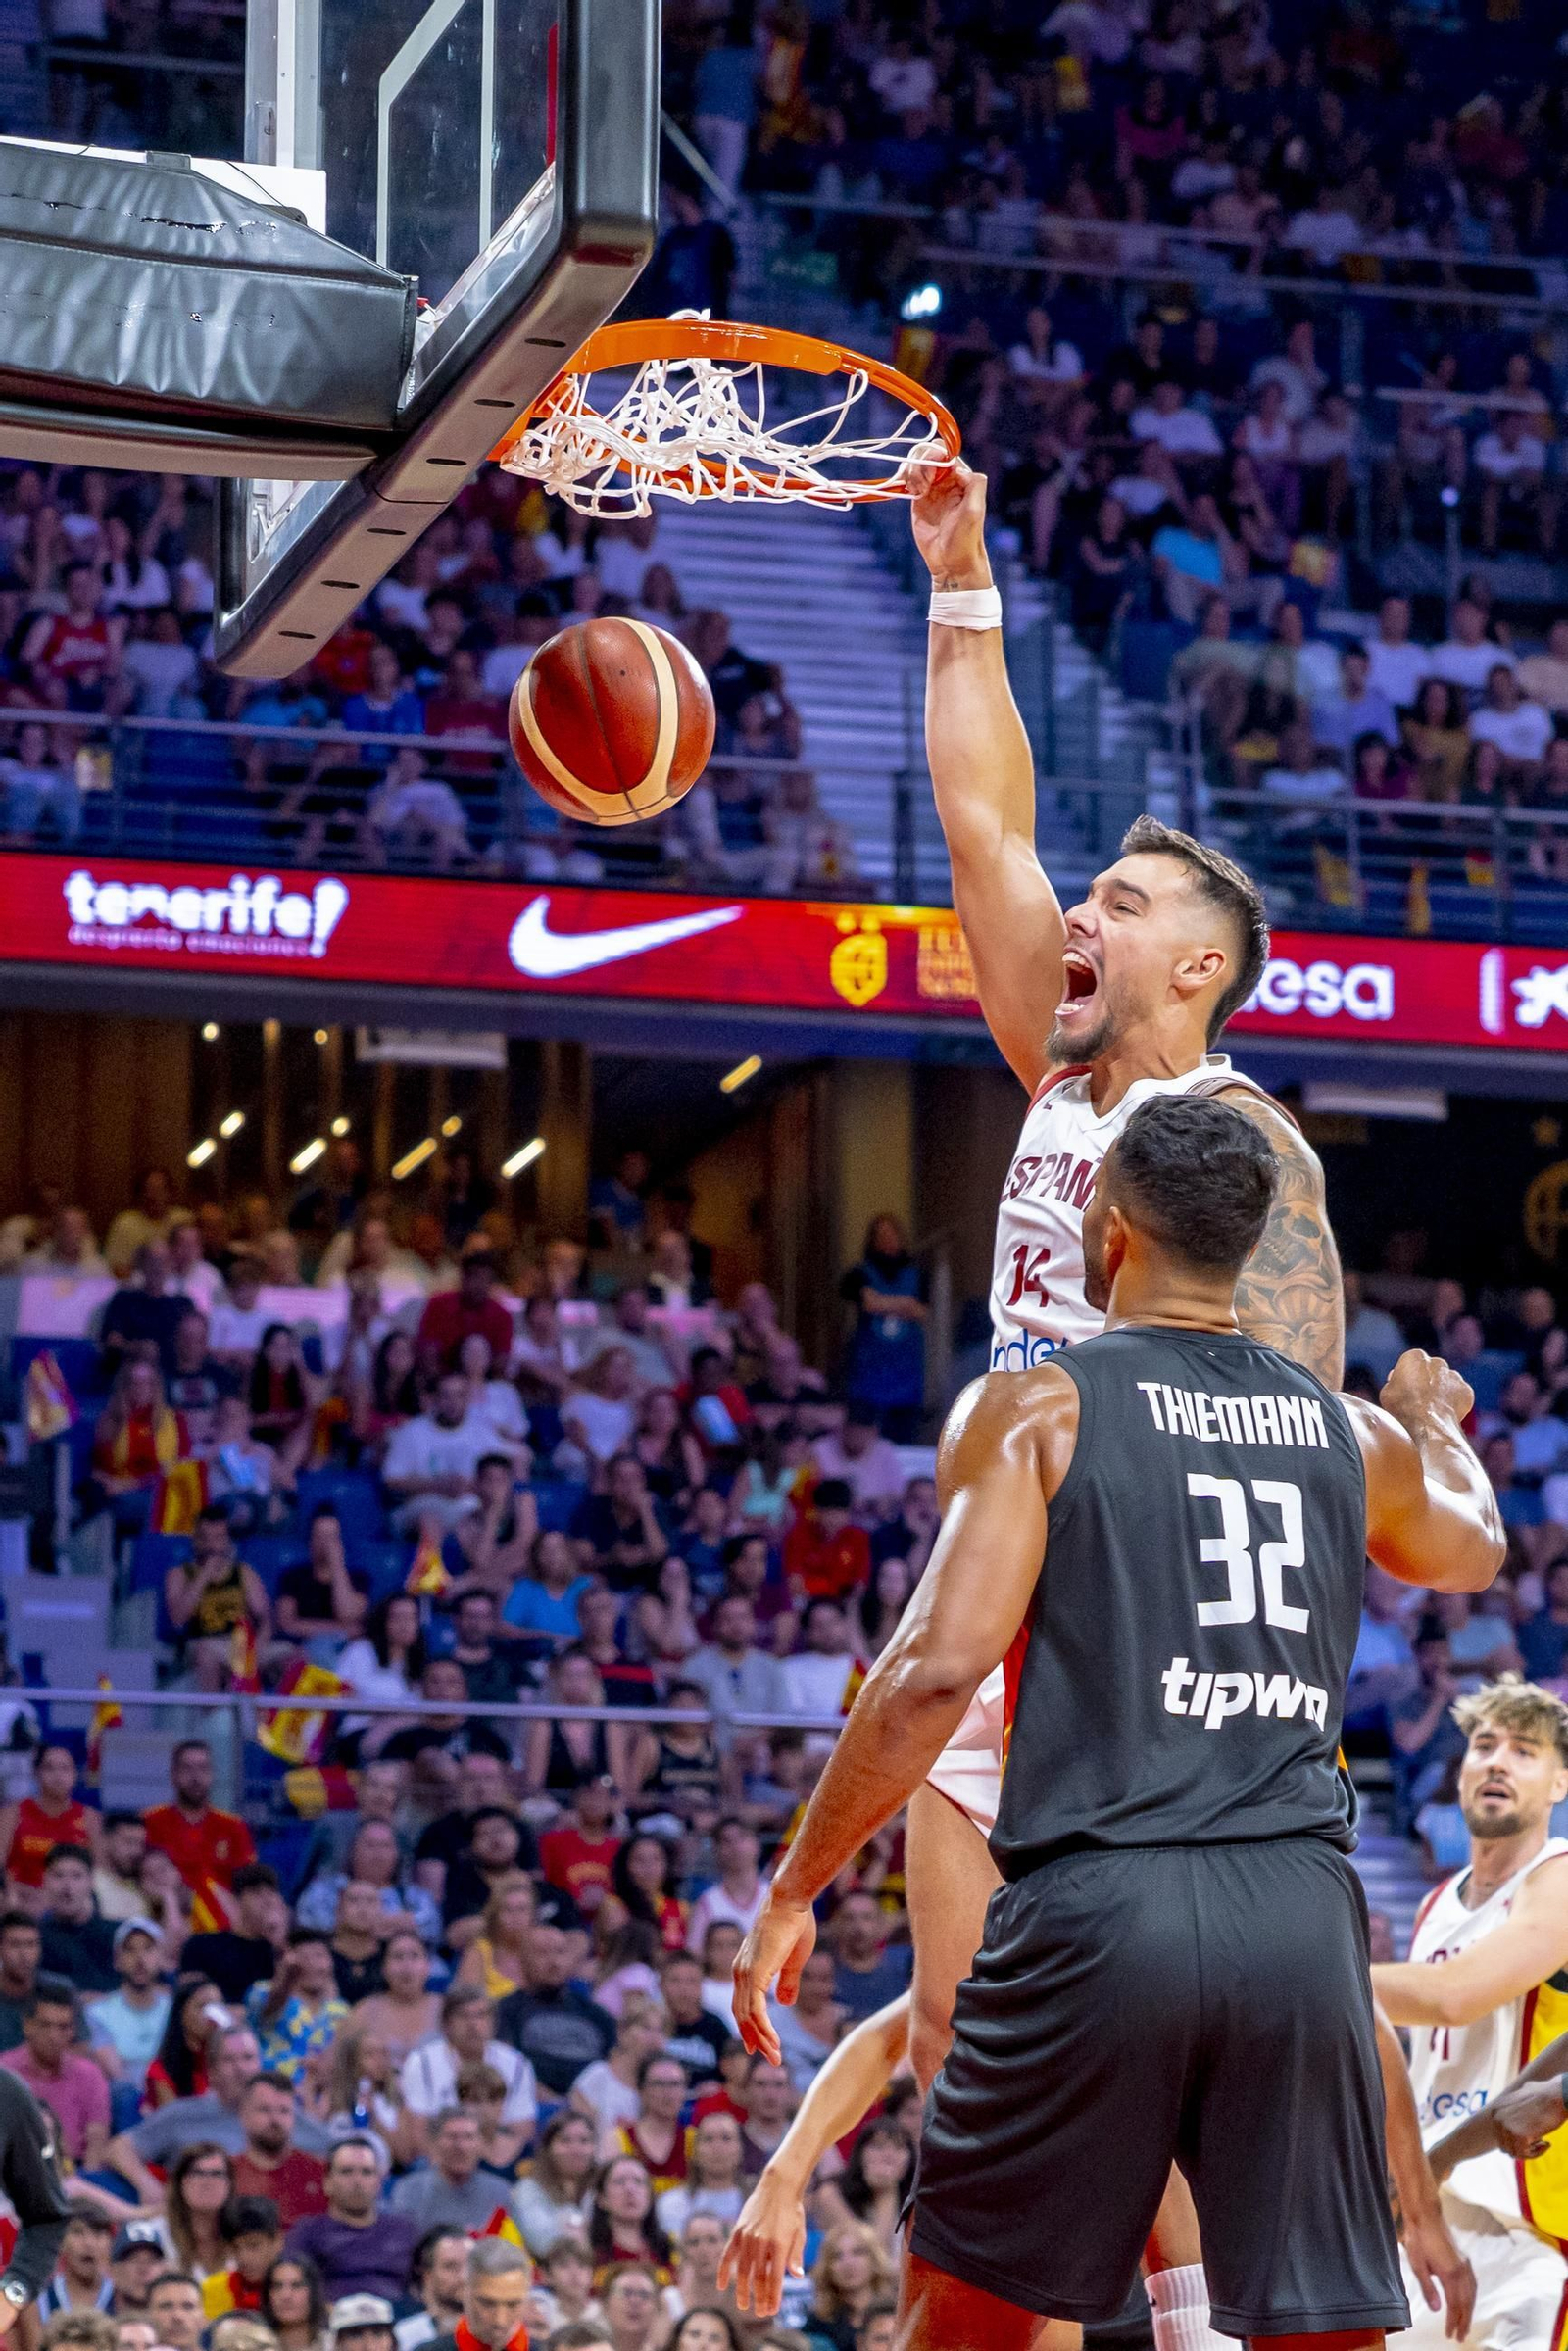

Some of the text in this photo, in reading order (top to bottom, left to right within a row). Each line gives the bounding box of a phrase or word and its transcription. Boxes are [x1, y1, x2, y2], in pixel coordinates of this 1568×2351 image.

[63, 869, 350, 958] tenerife!
[1237, 958, 1395, 1021] esa
[1006, 1244, 1051, 1307] 14
[1136, 1382, 1330, 1448] THIEMANN
[1187, 1473, 1309, 1634] 32
